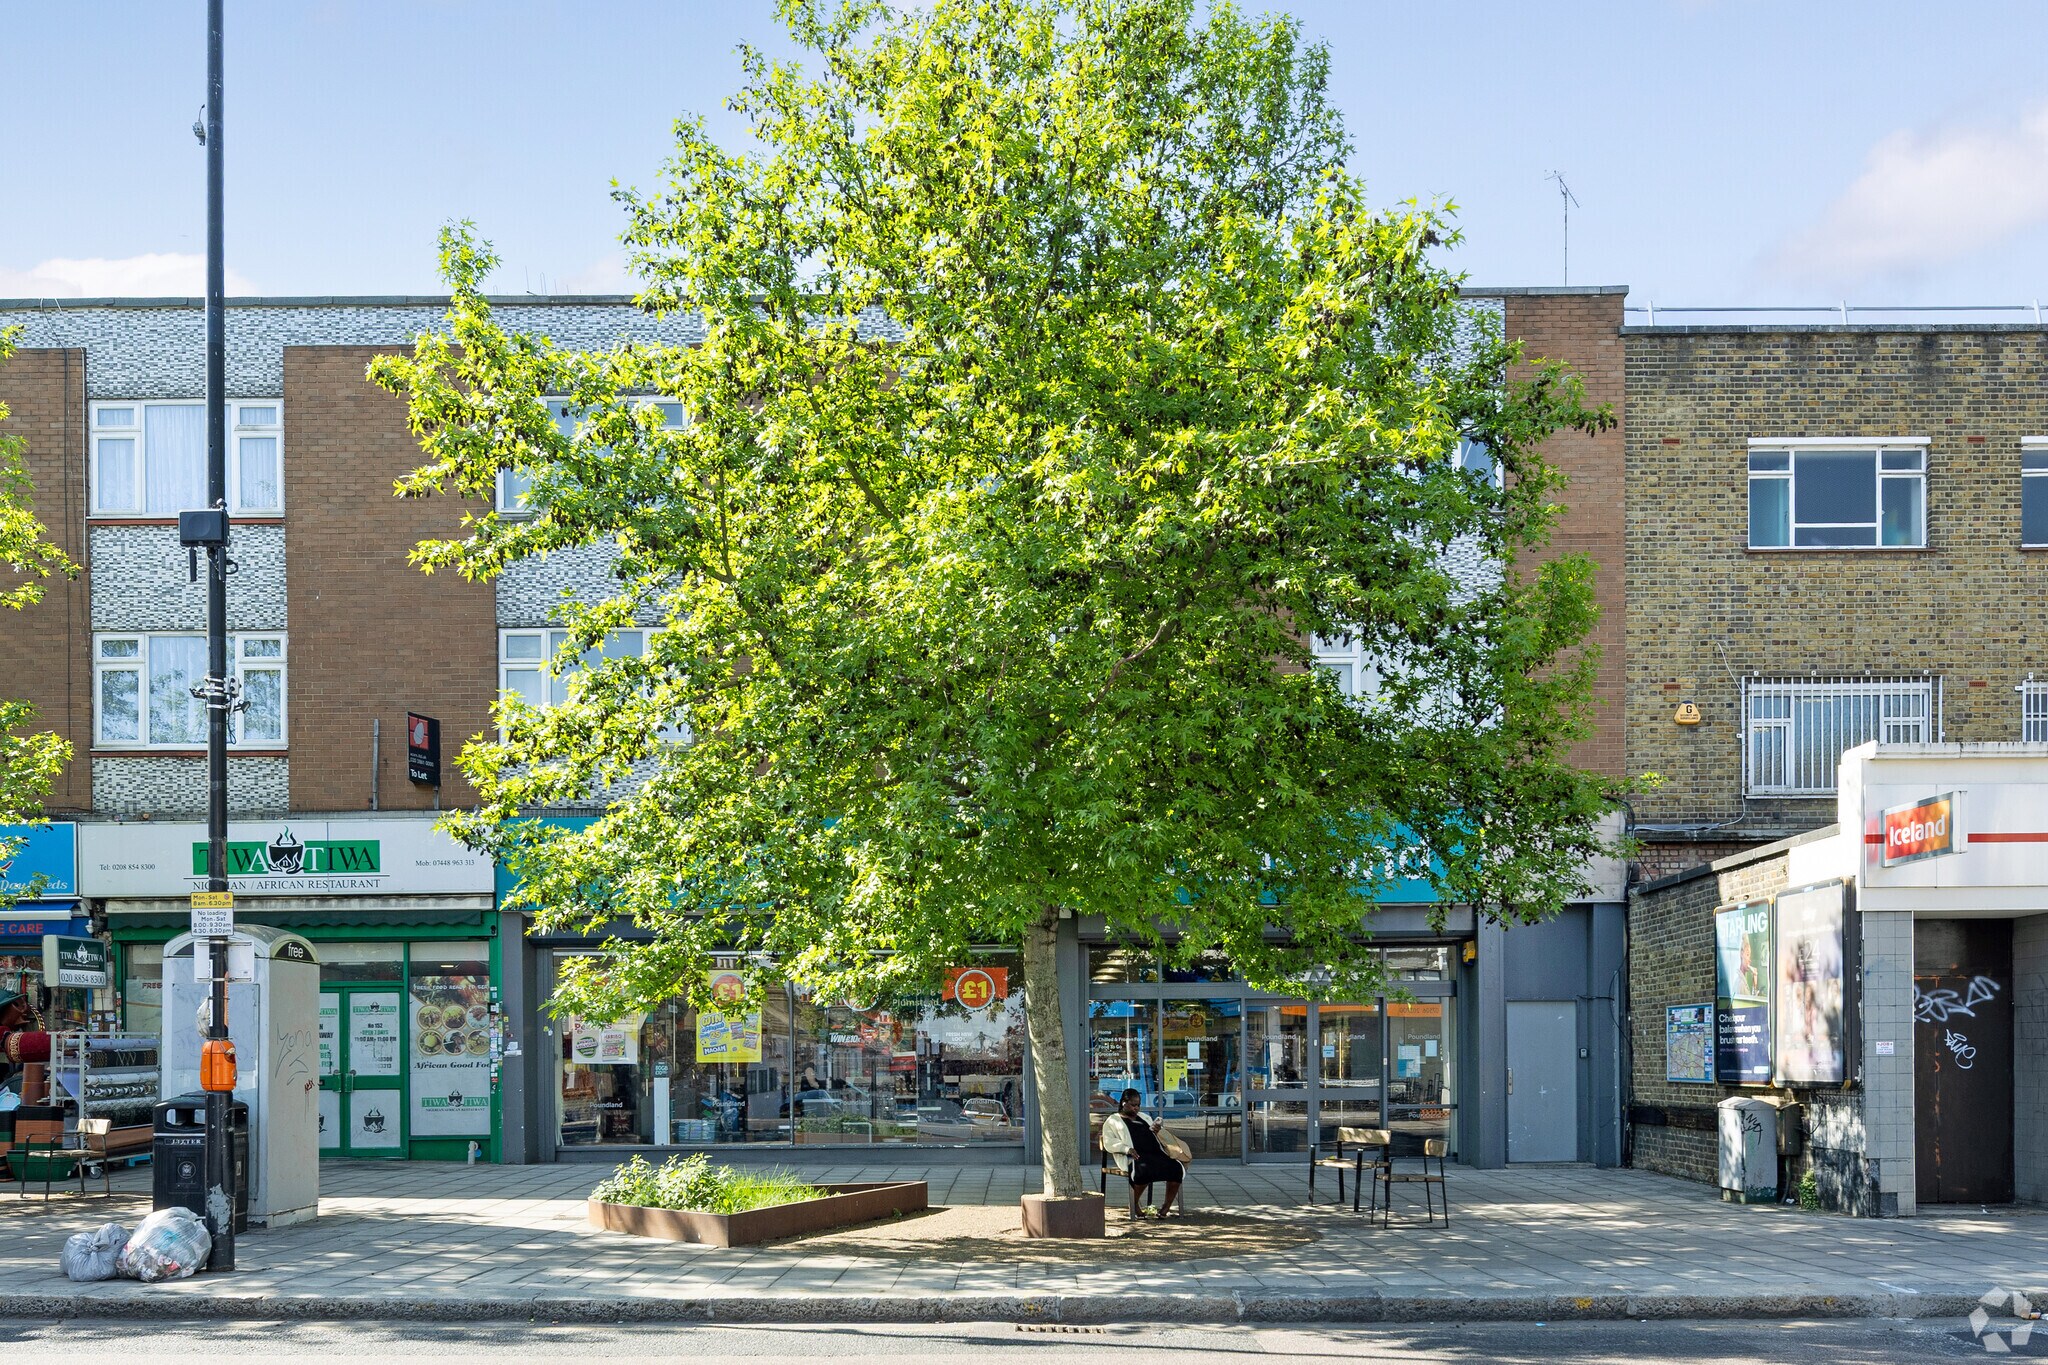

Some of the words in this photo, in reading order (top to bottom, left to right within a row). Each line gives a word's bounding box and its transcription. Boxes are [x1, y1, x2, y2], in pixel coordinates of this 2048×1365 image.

[410, 769, 417, 777] To
[418, 771, 427, 780] Let
[1890, 814, 1945, 847] Iceland
[199, 847, 269, 873] TWA
[304, 847, 377, 871] TIWA
[193, 881, 246, 890] NIIAN
[256, 880, 304, 890] AFRICAN
[308, 880, 380, 889] RESTAURANT
[8, 923, 44, 935] CARE
[288, 943, 304, 958] free
[60, 951, 77, 960] TIWA
[87, 953, 104, 962] TIWA
[61, 973, 72, 983] 020
[74, 973, 88, 983] 8854
[90, 975, 105, 985] 8300
[718, 983, 741, 1001] £1
[963, 981, 987, 999] £1
[892, 998, 939, 1007] Plumstd
[702, 1013, 723, 1026] WIN
[704, 1045, 727, 1055] MAOAM
[414, 1061, 447, 1070] African
[450, 1061, 474, 1069] Good
[423, 1098, 447, 1107] TIWA
[464, 1097, 488, 1106] TIWA
[839, 1099, 872, 1107] oundland
